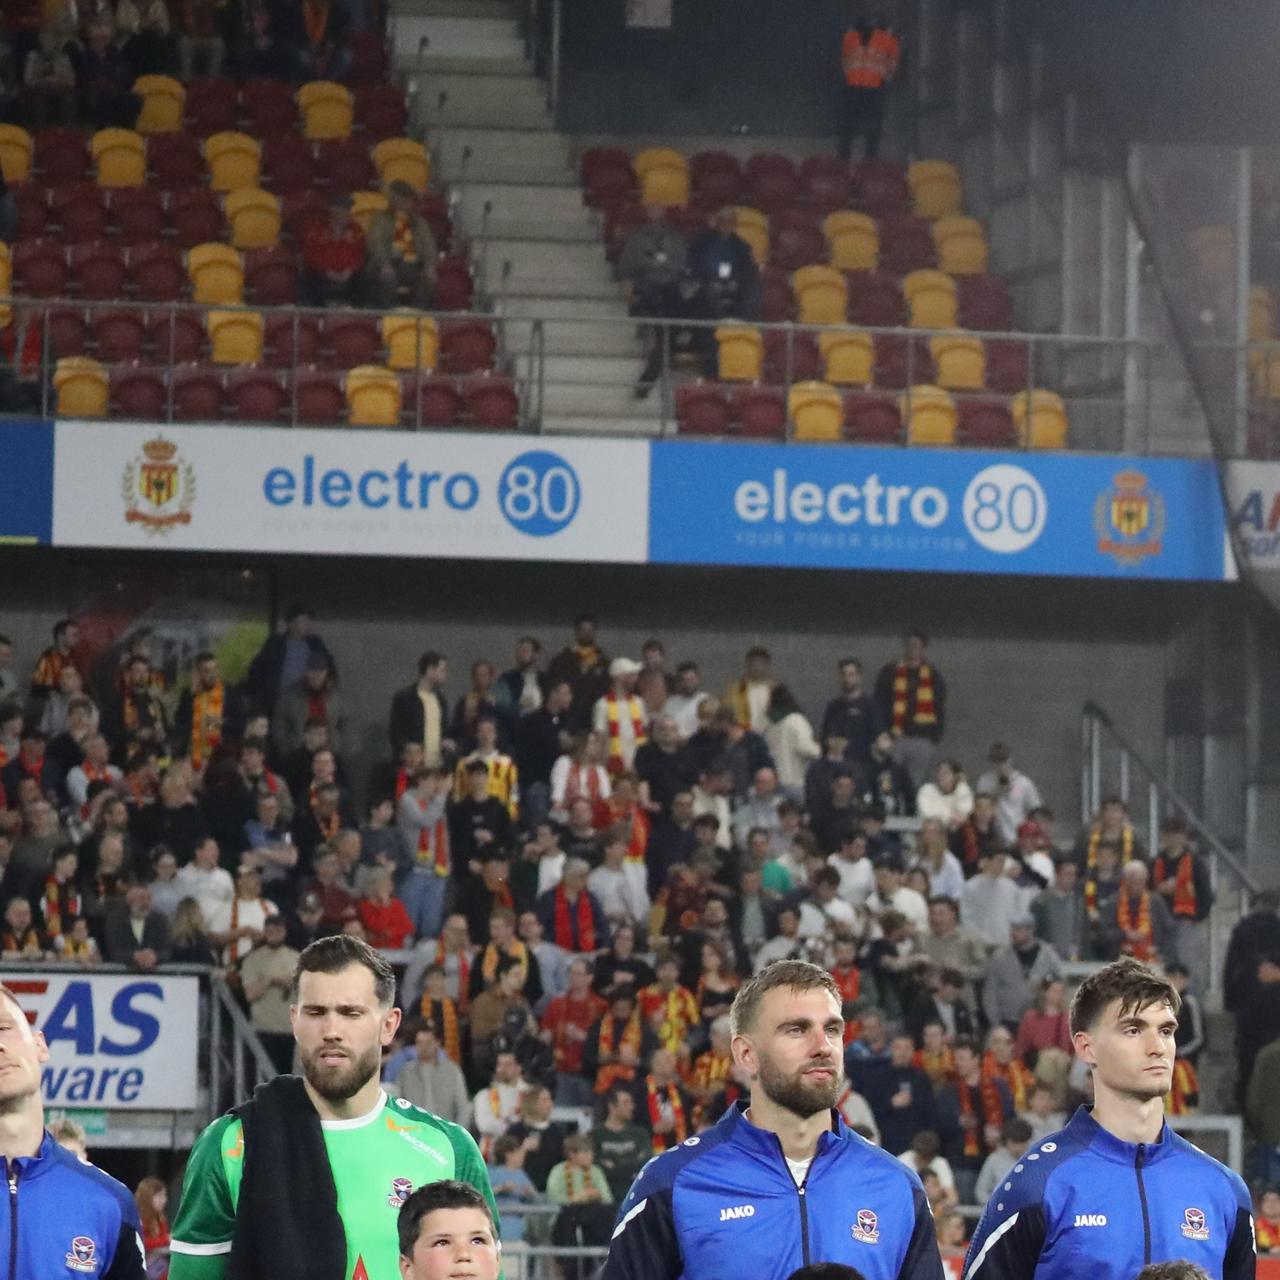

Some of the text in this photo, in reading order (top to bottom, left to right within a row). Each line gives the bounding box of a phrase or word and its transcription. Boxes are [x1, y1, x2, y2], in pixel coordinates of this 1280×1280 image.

[263, 454, 577, 521] electro 80
[734, 468, 1039, 534] electro 80
[42, 1066, 144, 1102] ware
[720, 1205, 754, 1221] JAKO
[1074, 1214, 1107, 1227] JAKO
